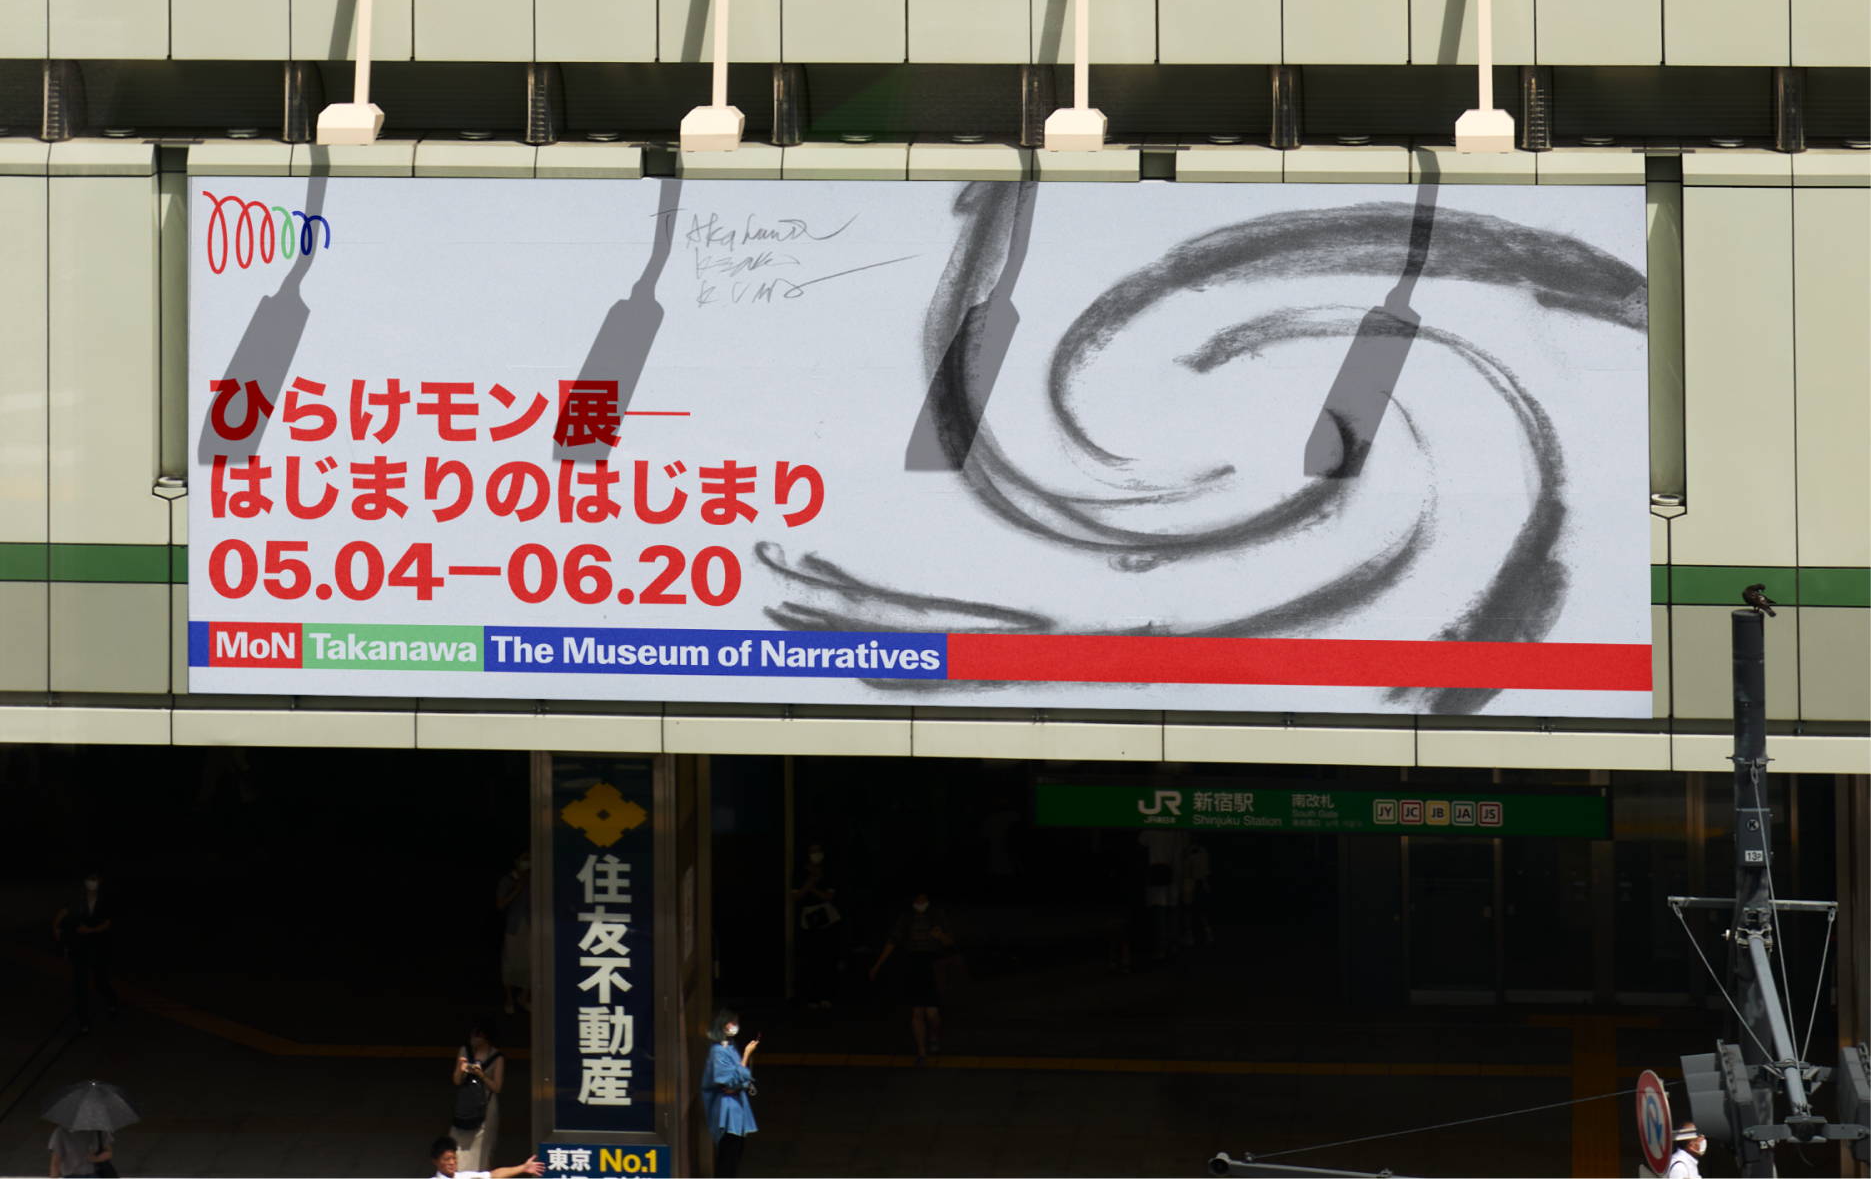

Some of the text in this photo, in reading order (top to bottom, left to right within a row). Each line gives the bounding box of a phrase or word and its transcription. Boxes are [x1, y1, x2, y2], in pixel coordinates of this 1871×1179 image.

[211, 455, 824, 527] はじまりのはじまり
[215, 631, 940, 670] MoN Takanawa The Museum of Narratives
[1137, 790, 1182, 815] JR
[1193, 791, 1254, 812] 新宿駅
[1292, 793, 1335, 809] 南改札
[1193, 814, 1240, 828] Shinjuku
[1243, 815, 1283, 827] Station
[1292, 808, 1339, 820] South Gate
[1378, 806, 1497, 820] JY JC JB JA JS
[576, 854, 634, 1107] 住友不動産
[547, 1147, 657, 1173] 東京 No.1
